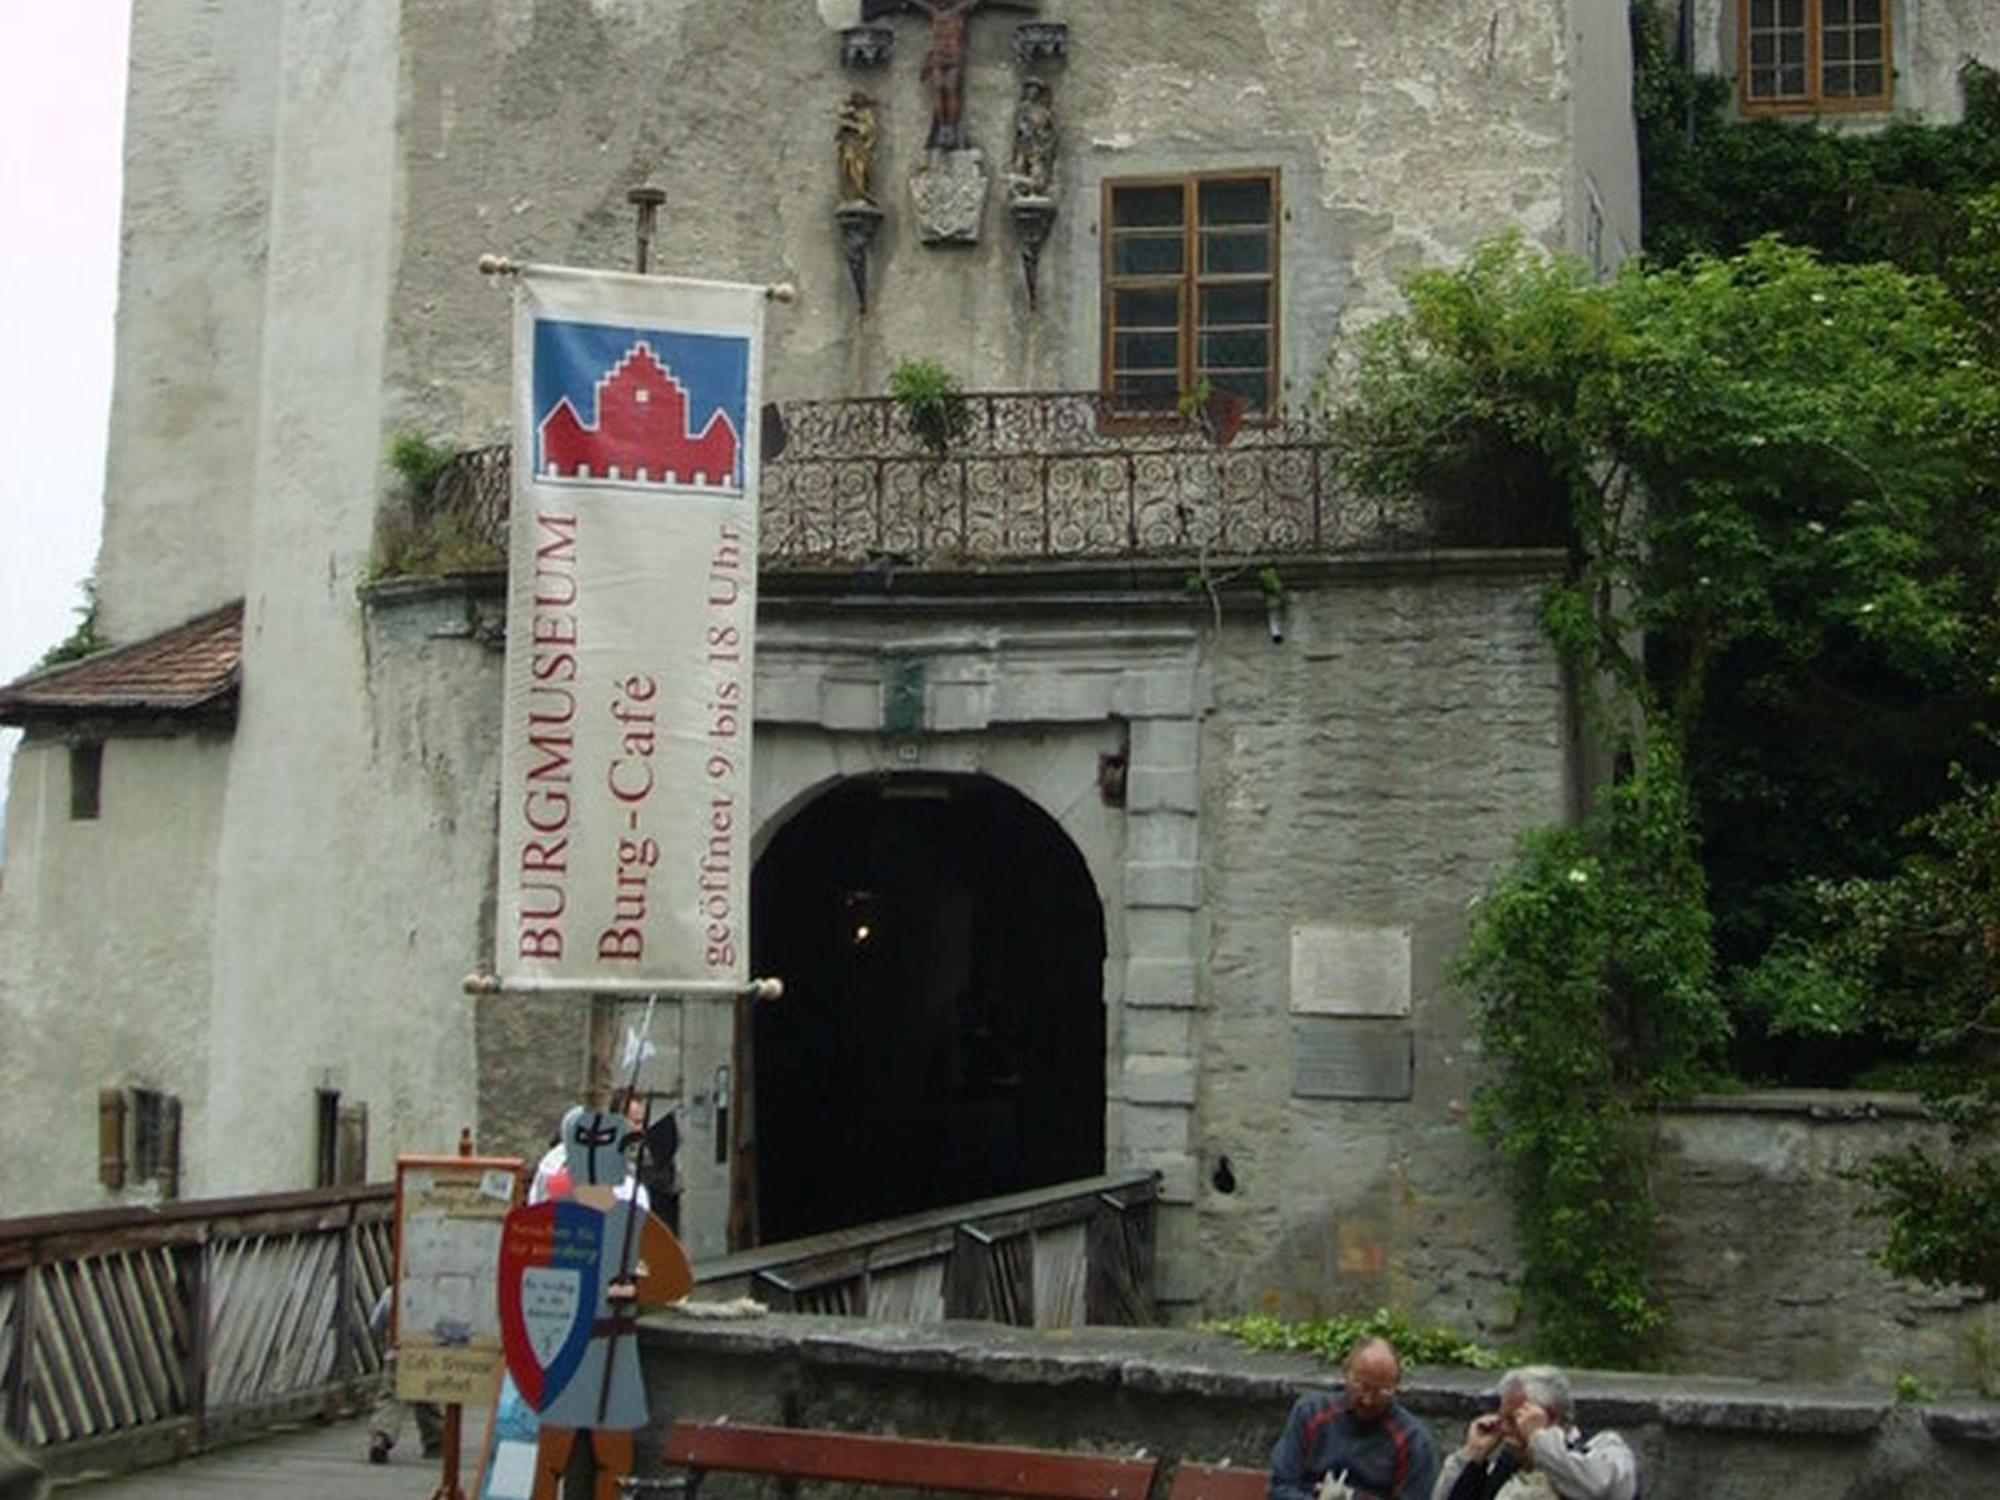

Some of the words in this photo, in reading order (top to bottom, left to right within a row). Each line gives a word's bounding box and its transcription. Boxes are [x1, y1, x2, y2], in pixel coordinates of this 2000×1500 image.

[708, 523, 740, 605] Uhr
[708, 626, 740, 662] 18
[519, 512, 577, 962] BURGMUSEUM
[707, 682, 740, 737] bis
[707, 756, 734, 778] 9
